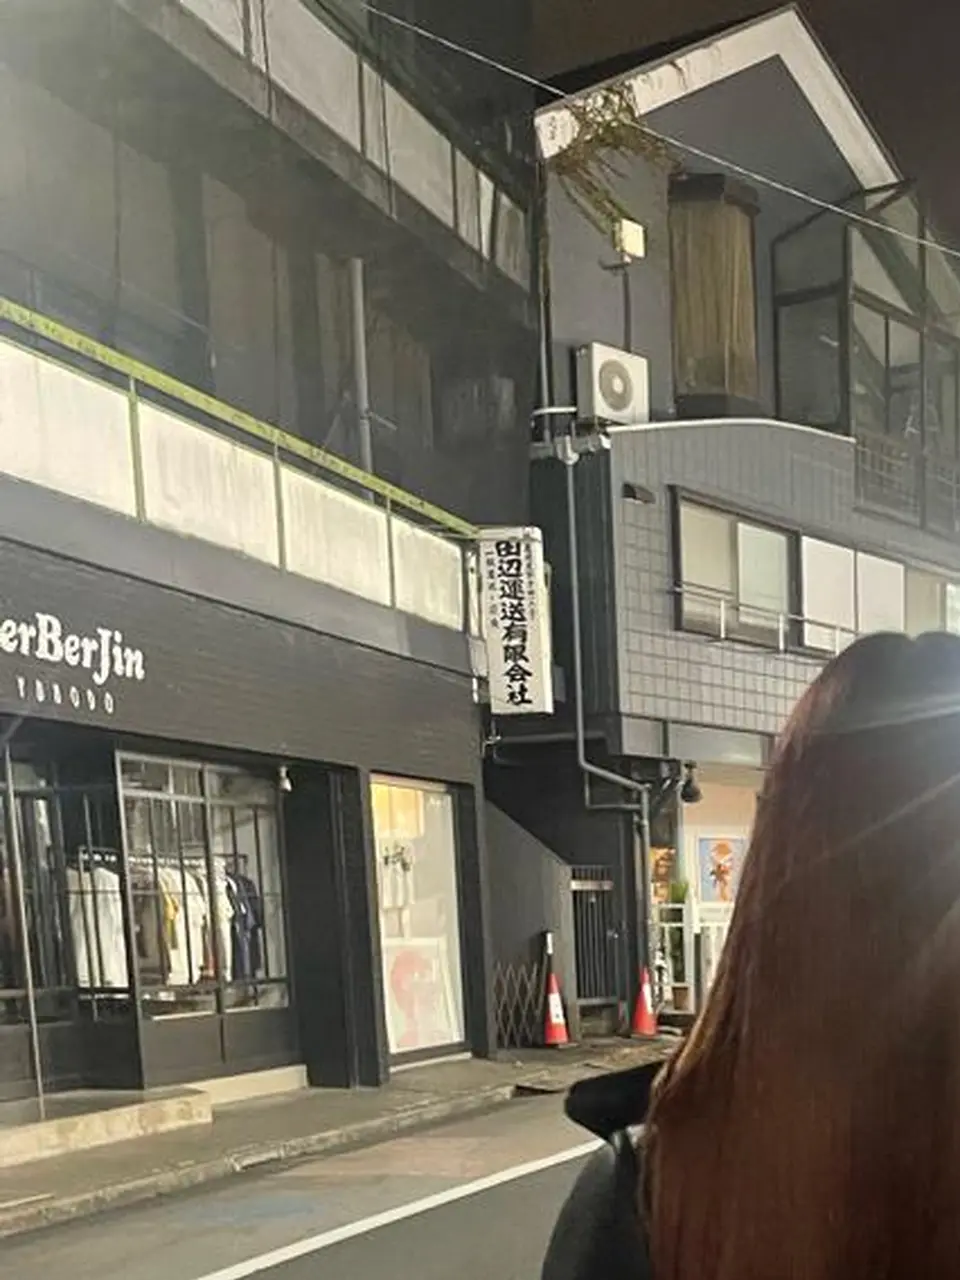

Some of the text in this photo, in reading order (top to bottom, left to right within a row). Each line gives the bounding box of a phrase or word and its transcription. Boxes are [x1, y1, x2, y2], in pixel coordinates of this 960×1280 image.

[0, 612, 145, 685] erBerJin
[495, 540, 533, 705] 田辺運送有限会社
